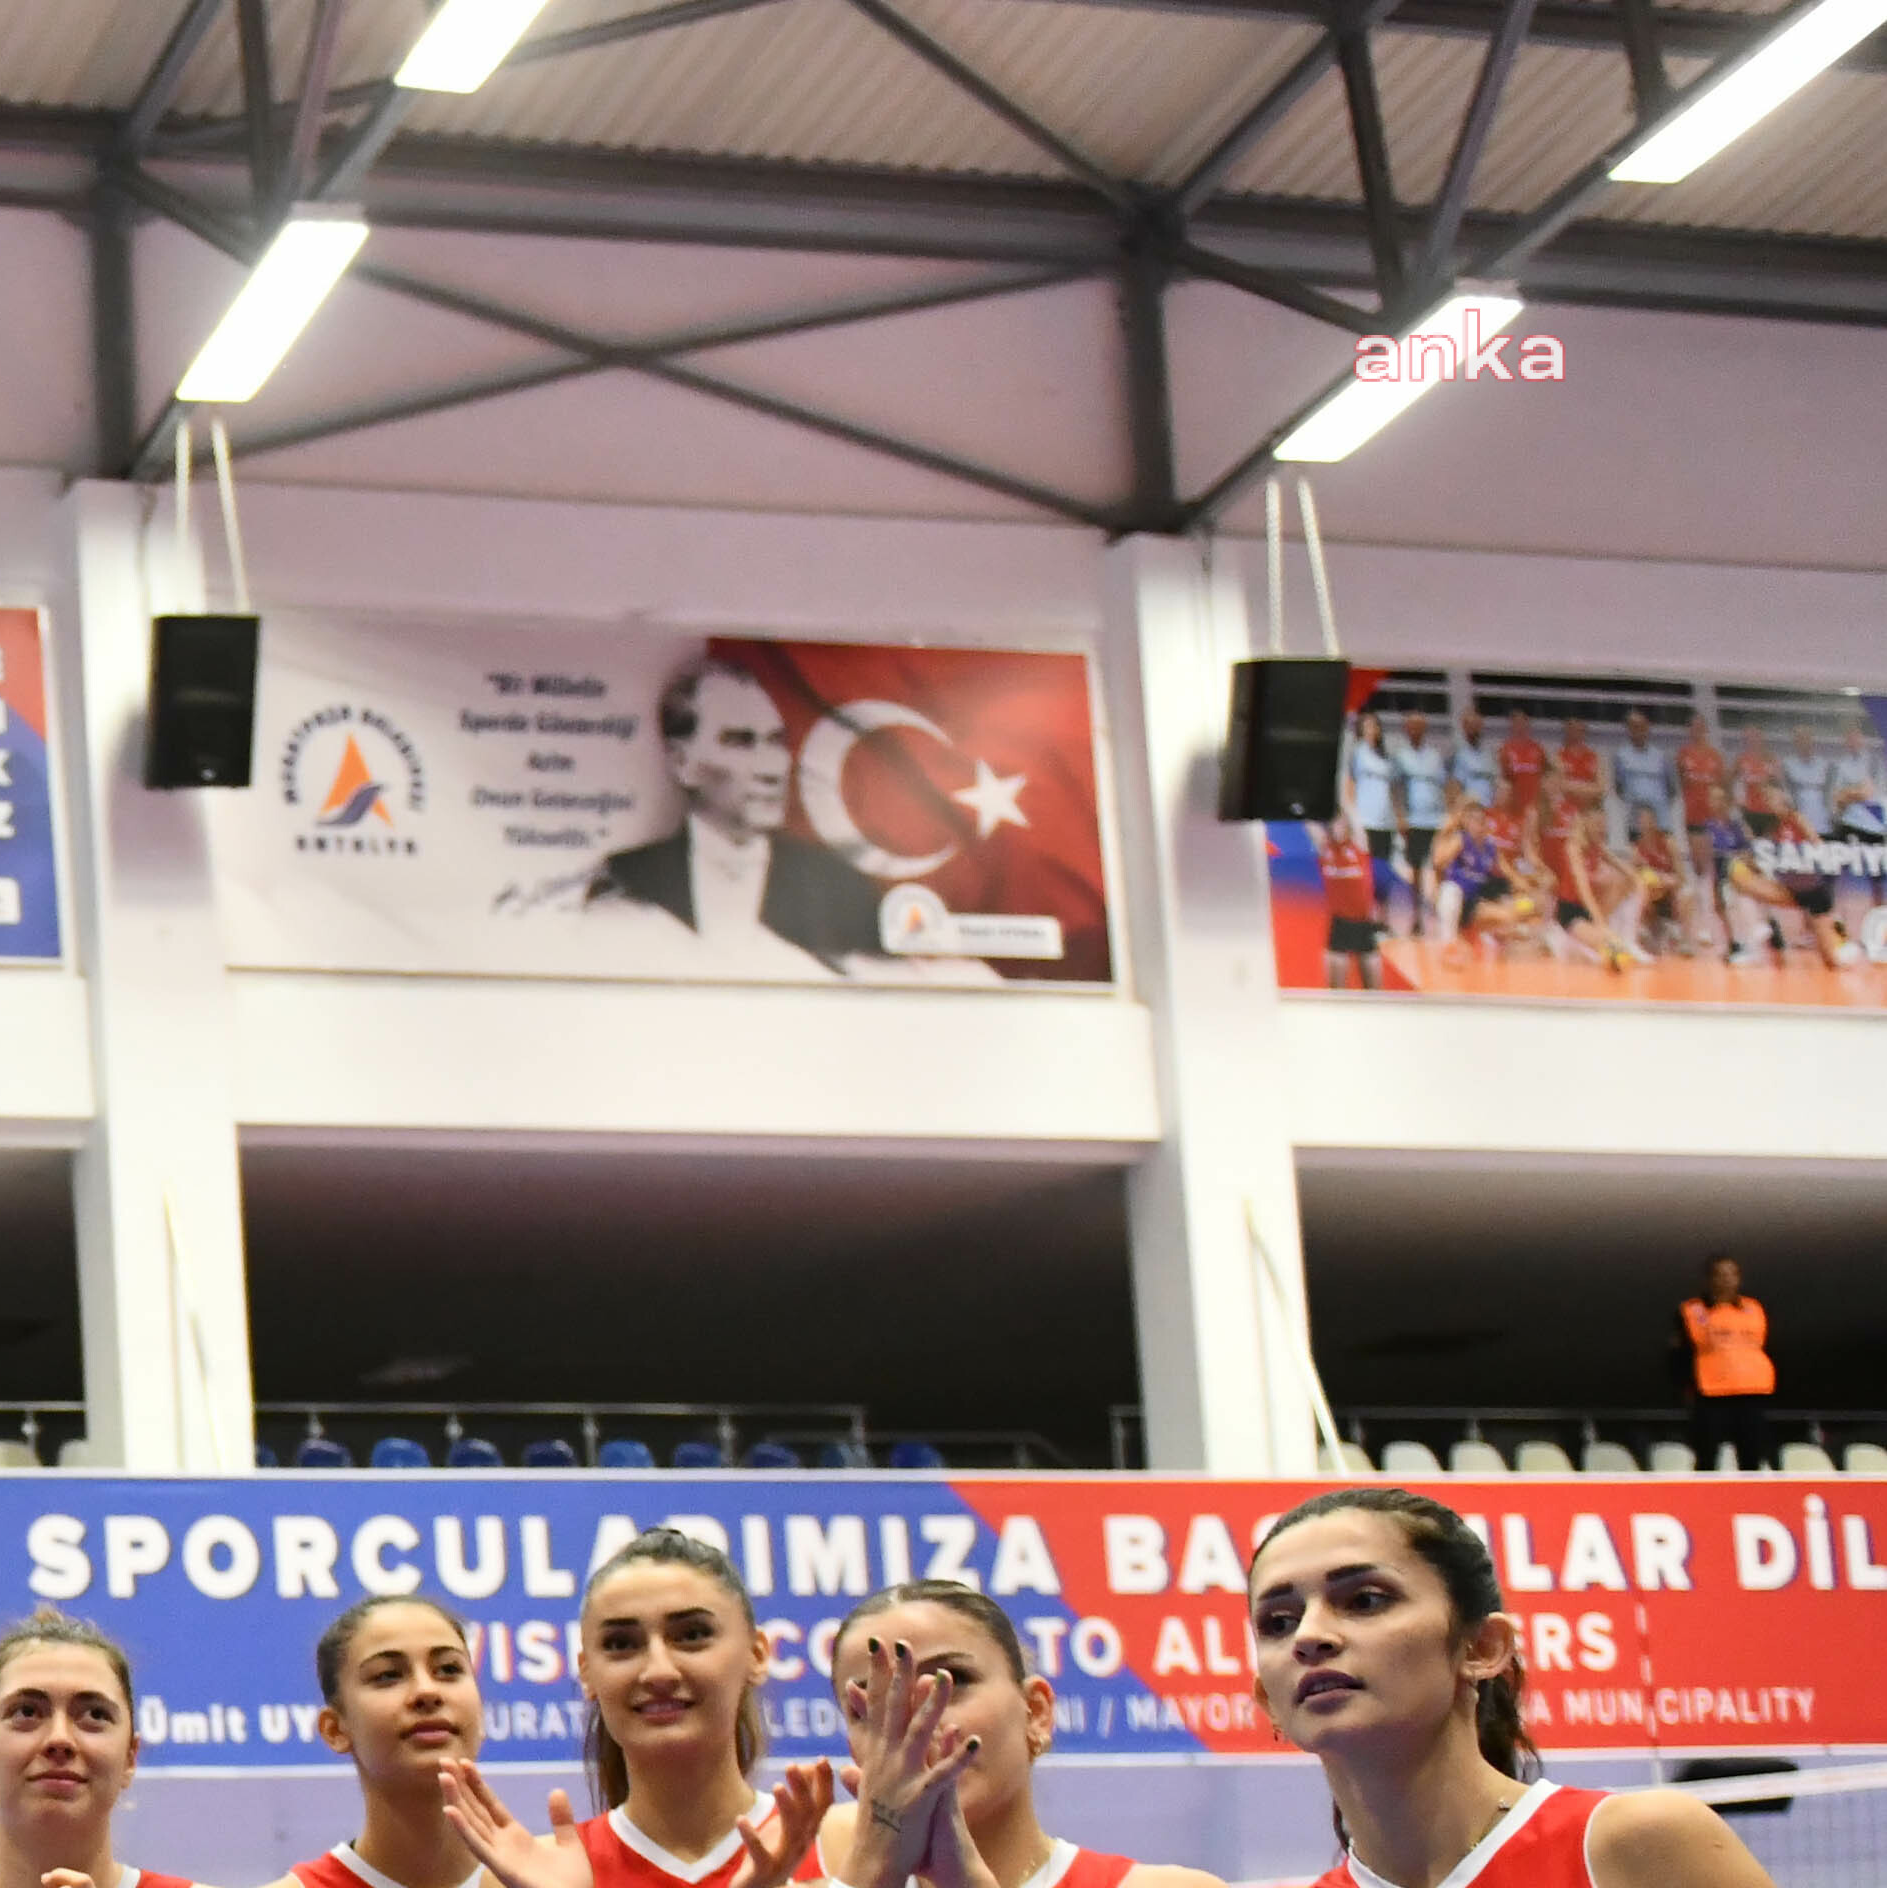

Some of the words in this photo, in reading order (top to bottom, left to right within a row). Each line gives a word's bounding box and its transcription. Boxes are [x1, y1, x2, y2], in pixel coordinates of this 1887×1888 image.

[1751, 833, 1887, 880] ŞAMPİY
[1026, 1616, 1123, 1678] TO
[139, 1696, 247, 1744] Ümit
[1126, 1693, 1256, 1732] MAYOR
[1563, 1686, 1815, 1726] MUNCIPALITY
